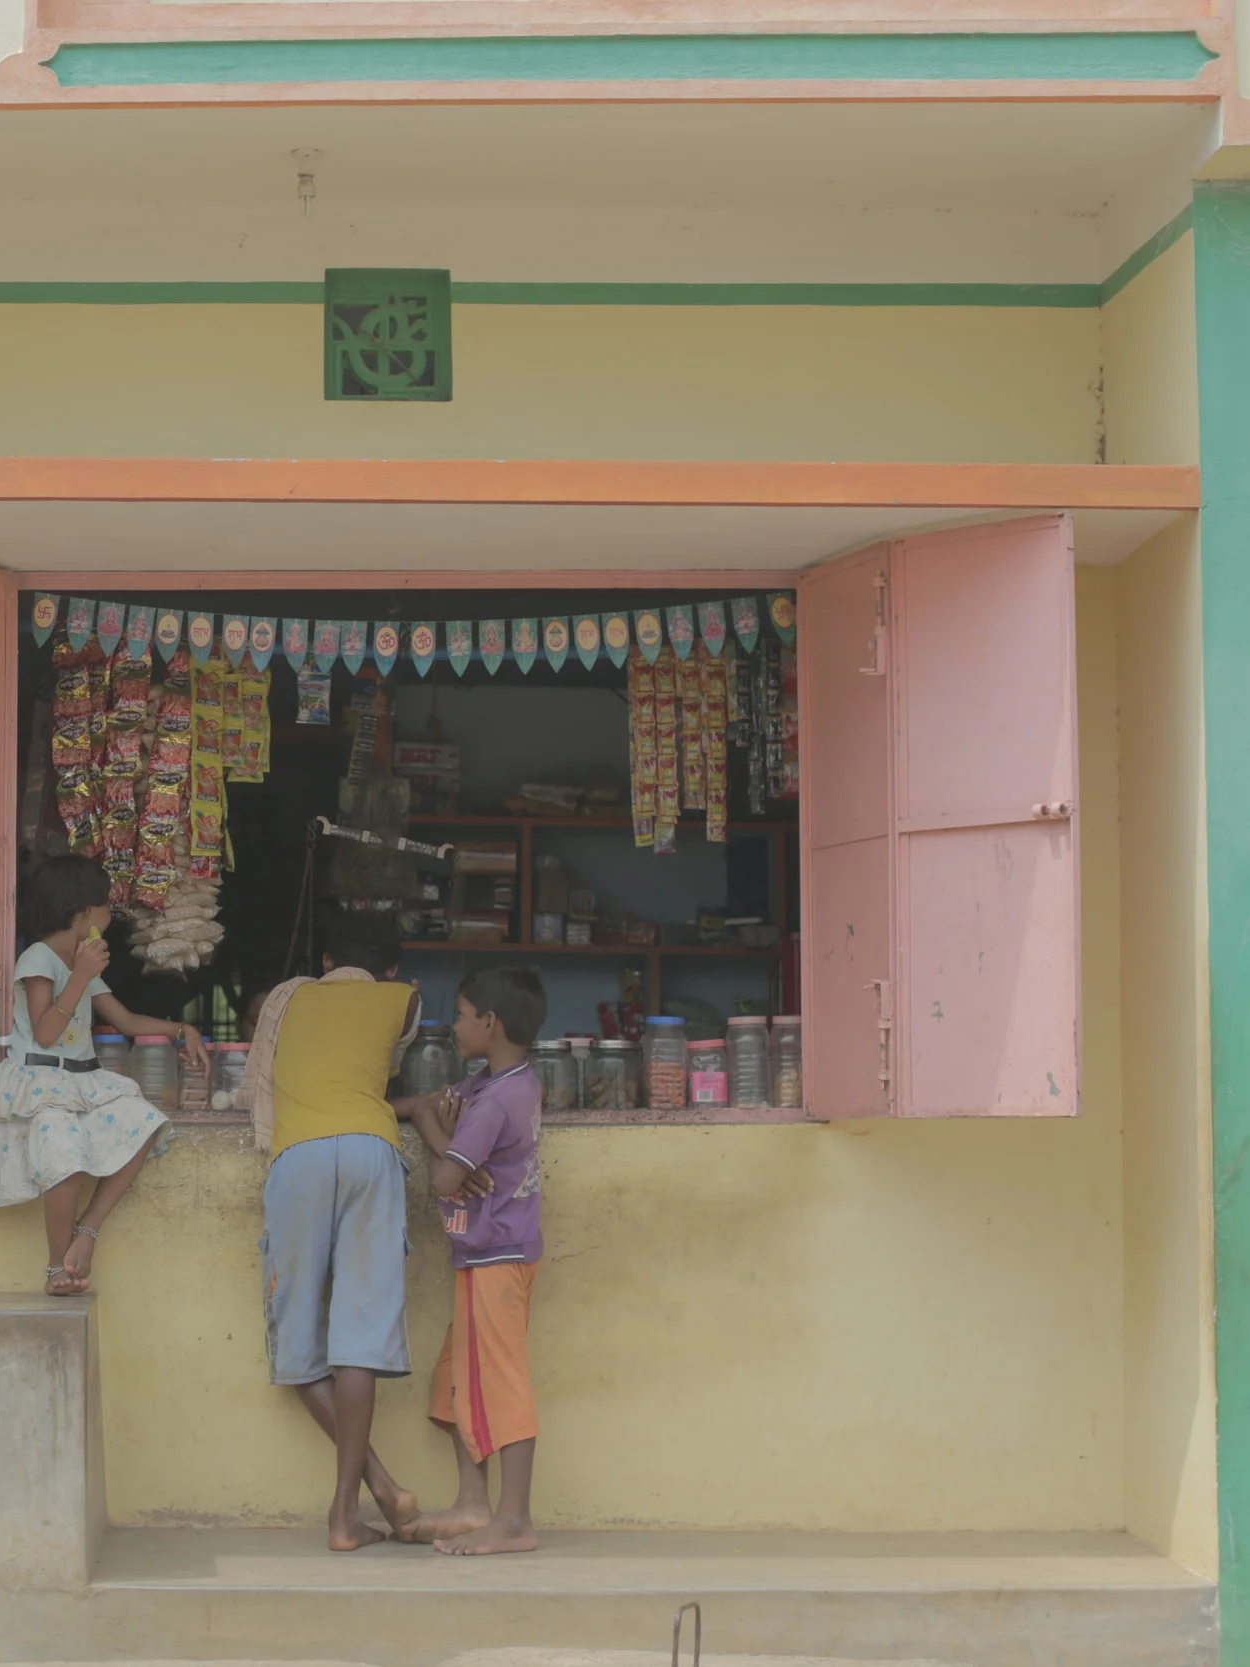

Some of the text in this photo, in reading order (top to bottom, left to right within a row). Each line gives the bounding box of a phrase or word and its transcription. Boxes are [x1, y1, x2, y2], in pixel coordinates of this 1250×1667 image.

[192, 627, 210, 639] लाभ
[228, 629, 243, 644] शुभ
[378, 631, 396, 650] ॐ
[414, 631, 432, 650] ॐ
